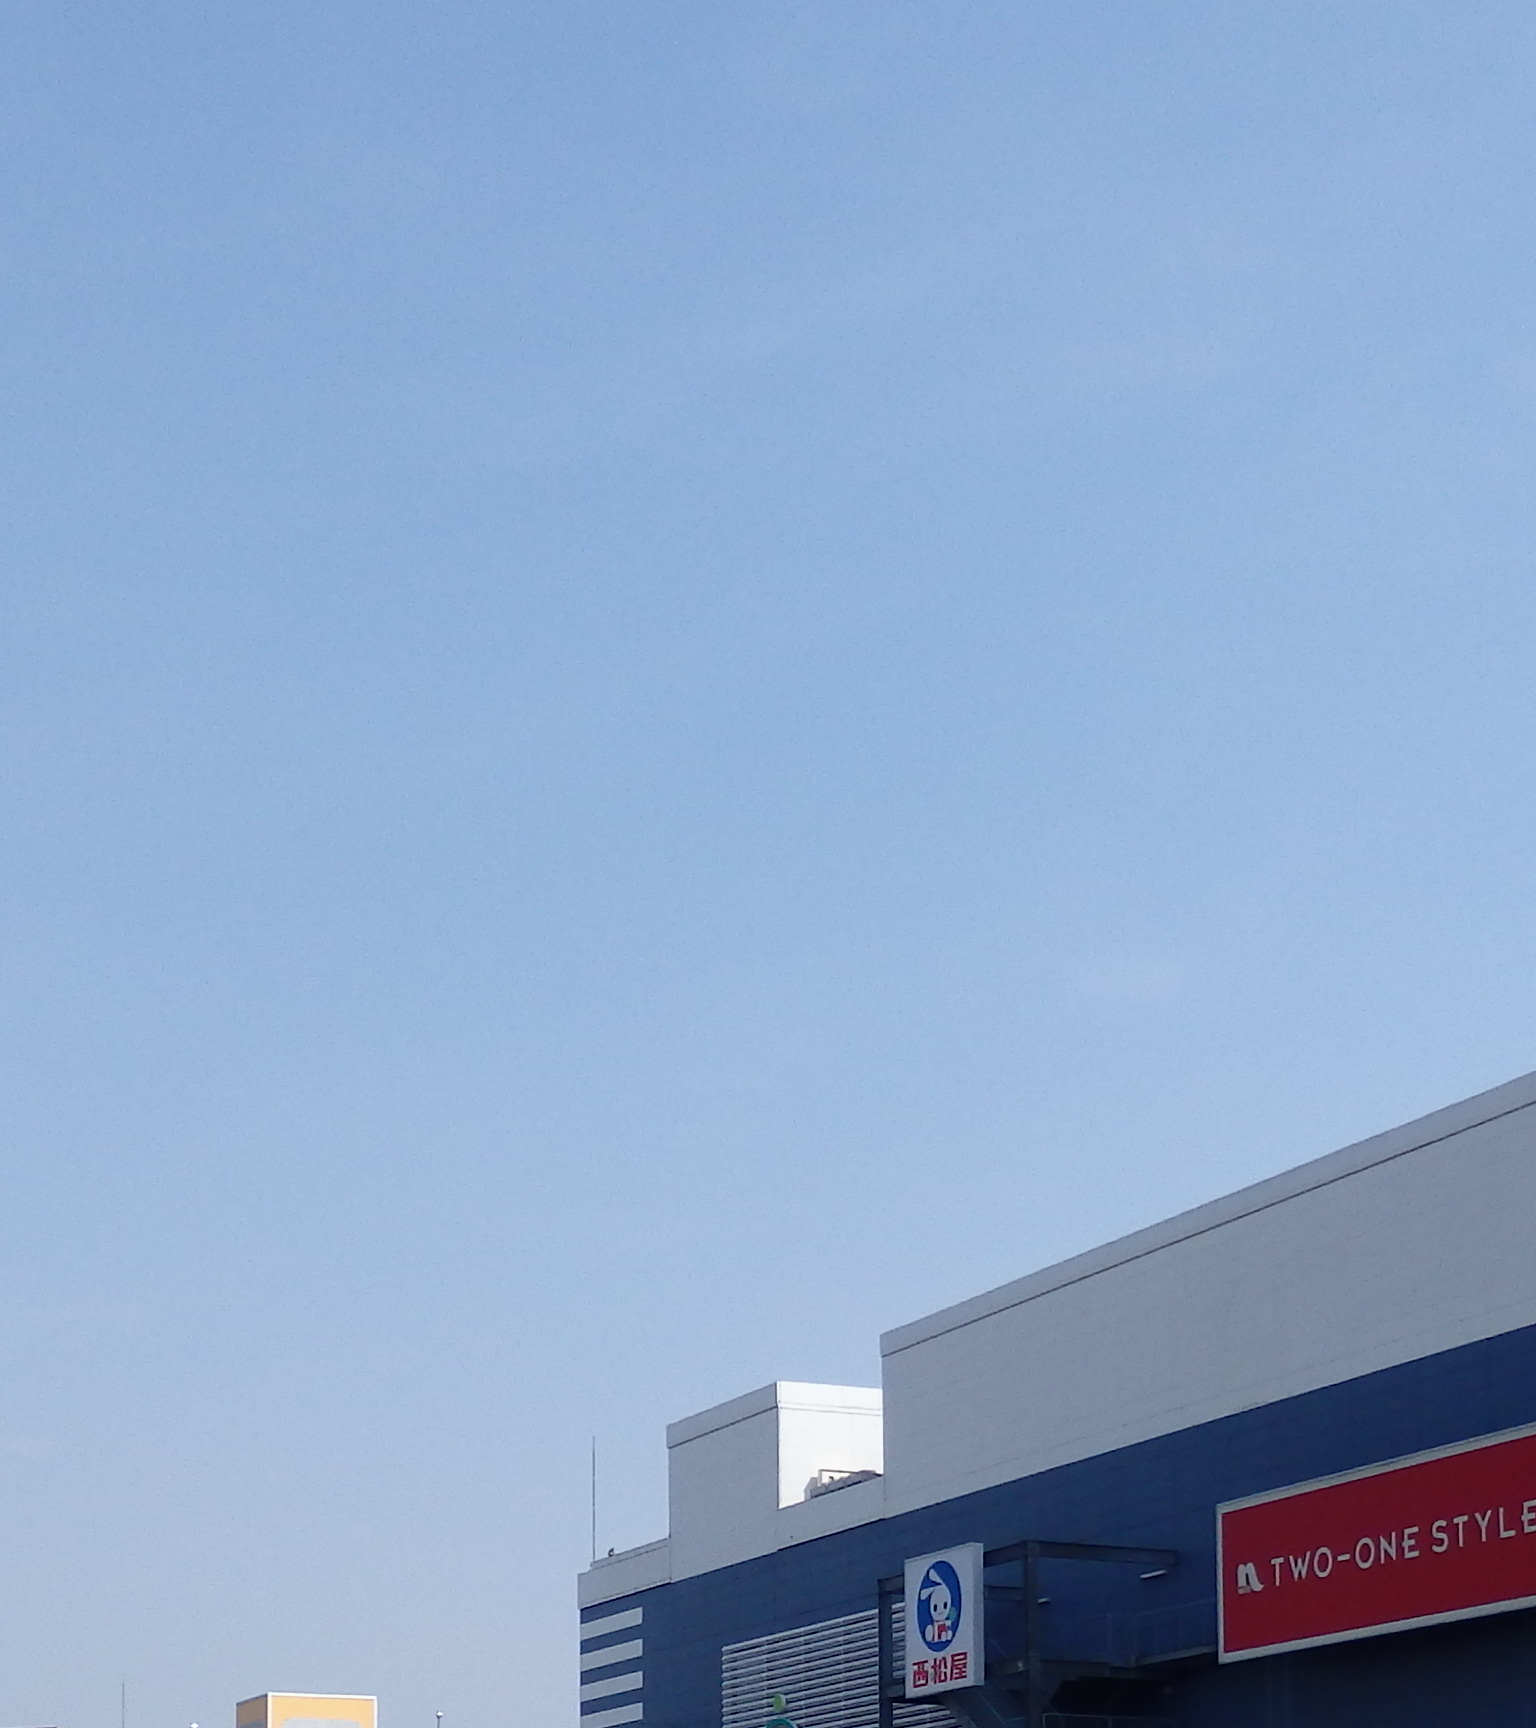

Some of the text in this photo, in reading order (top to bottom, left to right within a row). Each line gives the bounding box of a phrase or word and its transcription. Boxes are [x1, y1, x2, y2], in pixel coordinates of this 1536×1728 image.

[1270, 1526, 1420, 1588] TWO-ONE
[912, 1652, 968, 1689] 西松屋
